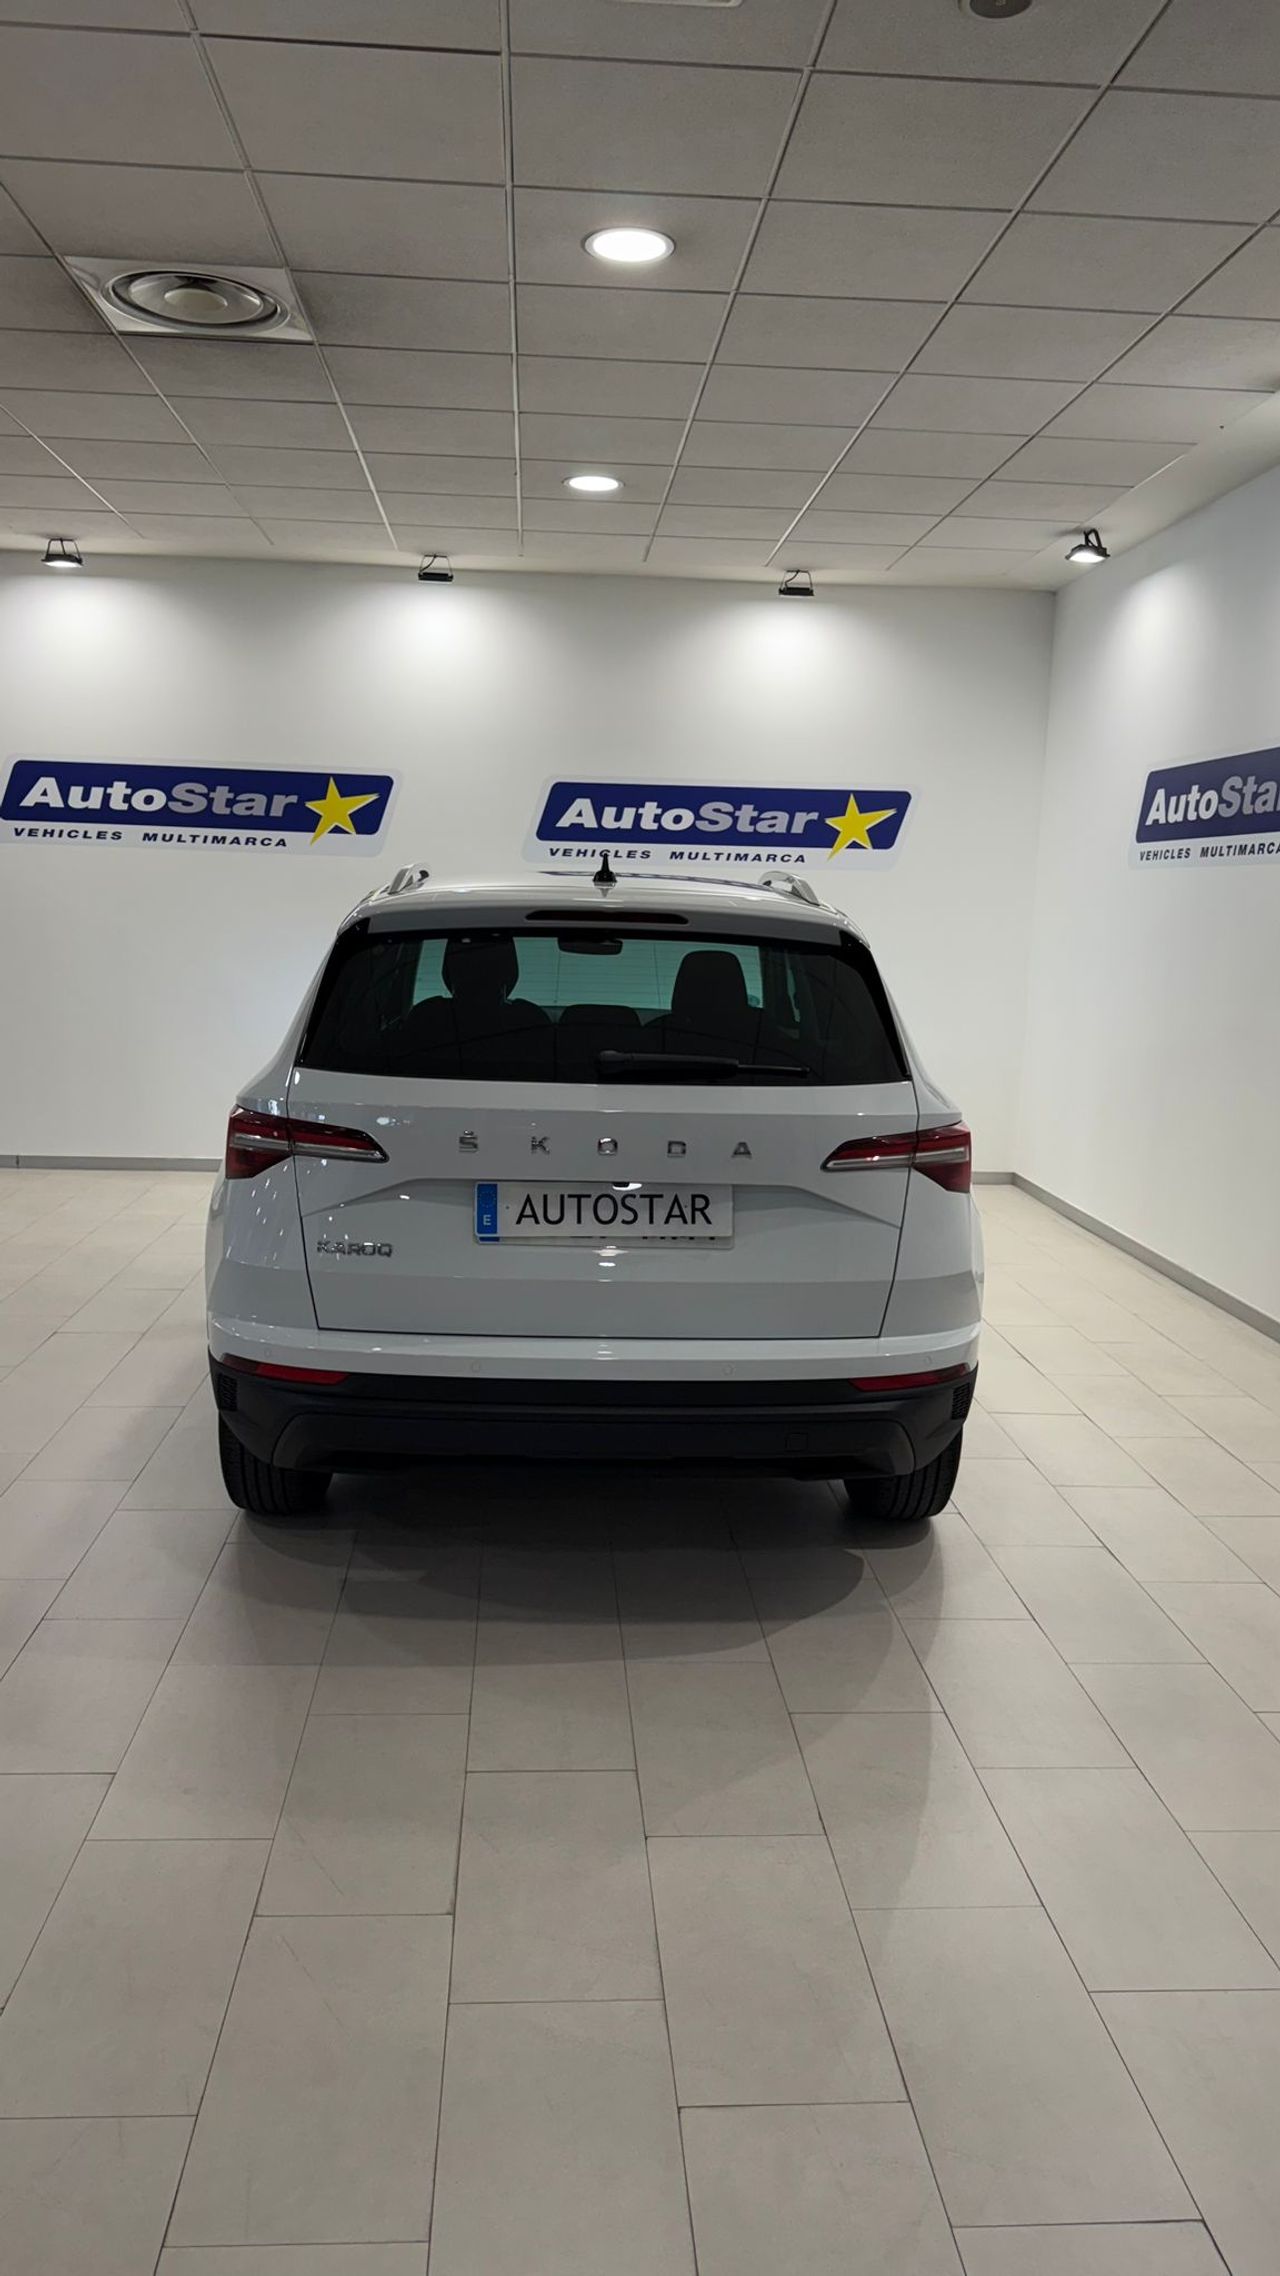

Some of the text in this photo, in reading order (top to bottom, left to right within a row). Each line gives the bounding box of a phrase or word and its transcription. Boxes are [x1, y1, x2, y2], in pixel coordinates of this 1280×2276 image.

[19, 776, 298, 817] AutoStar
[1144, 775, 1280, 826] AutoSta
[555, 797, 819, 834] AutoStar
[13, 827, 288, 848] VEHICLES MULTIMARCA
[549, 847, 806, 864] VEHICLES MULTIMARCA
[1139, 848, 1191, 861] VEHICLES
[515, 1193, 713, 1225] AUTOSTAR
[483, 1214, 492, 1226] E
[317, 1240, 393, 1258] KAROQ
